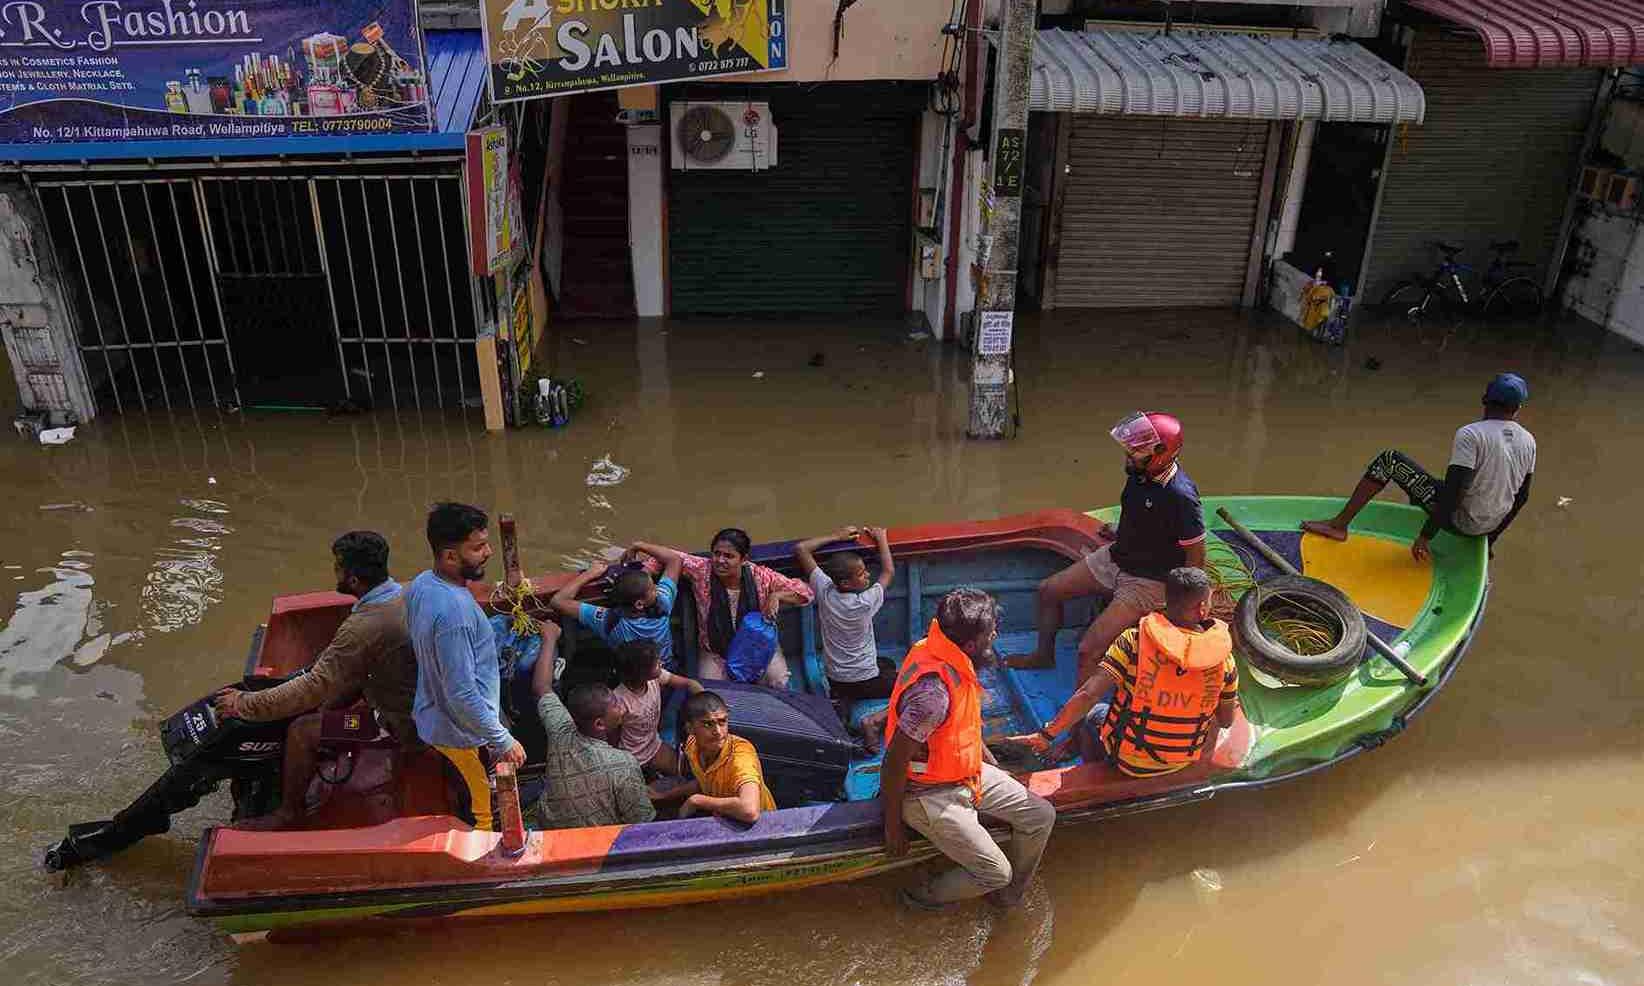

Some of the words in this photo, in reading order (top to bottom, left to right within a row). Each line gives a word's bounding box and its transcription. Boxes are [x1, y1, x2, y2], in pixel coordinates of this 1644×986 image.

[80, 0, 251, 51] Fashion
[33, 127, 52, 138] No.
[291, 121, 319, 133] TEL:
[321, 118, 393, 132] 0773790004
[1156, 689, 1193, 709] DIV
[192, 711, 208, 732] 25
